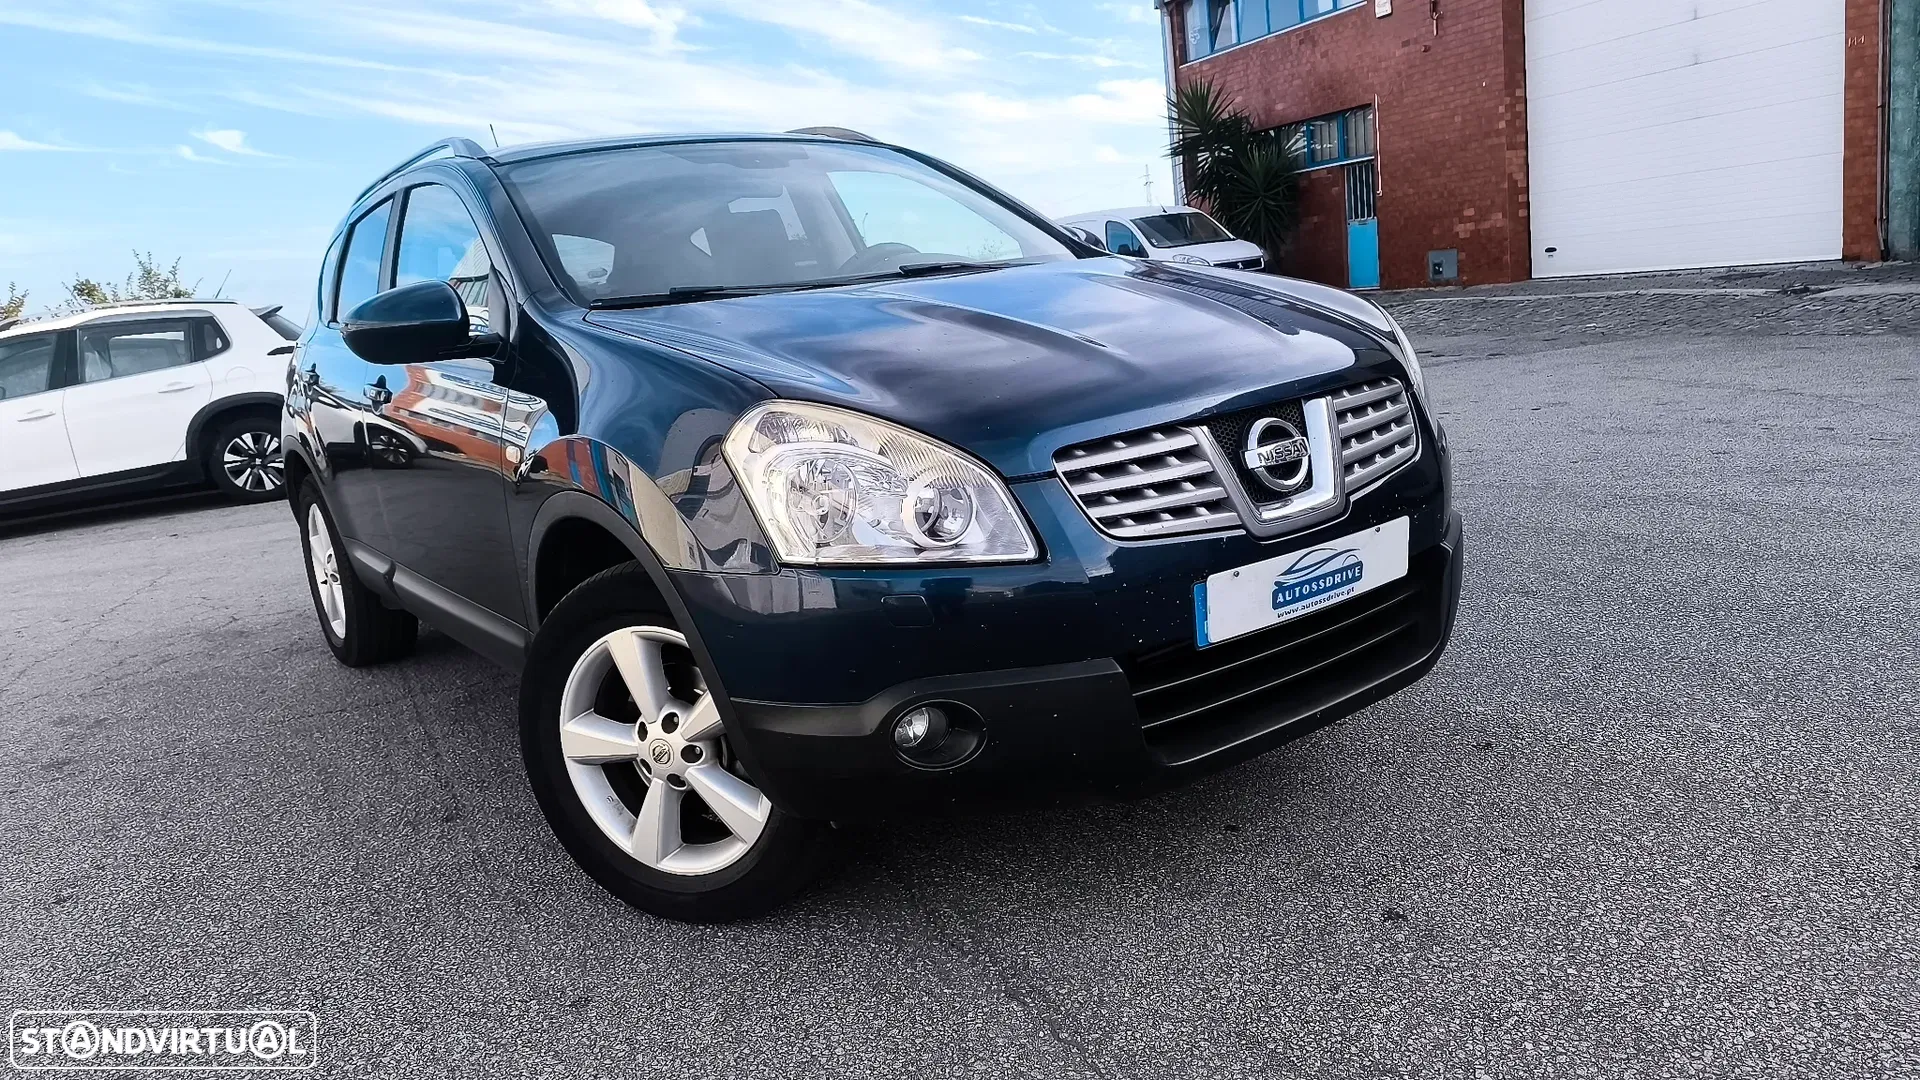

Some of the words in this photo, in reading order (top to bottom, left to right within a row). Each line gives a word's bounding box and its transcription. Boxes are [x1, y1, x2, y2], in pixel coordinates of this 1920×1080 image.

[1257, 439, 1307, 464] NISSAN
[1276, 565, 1361, 604] AUTOSSDRIVE
[1277, 586, 1355, 618] www.autossdrive.pt
